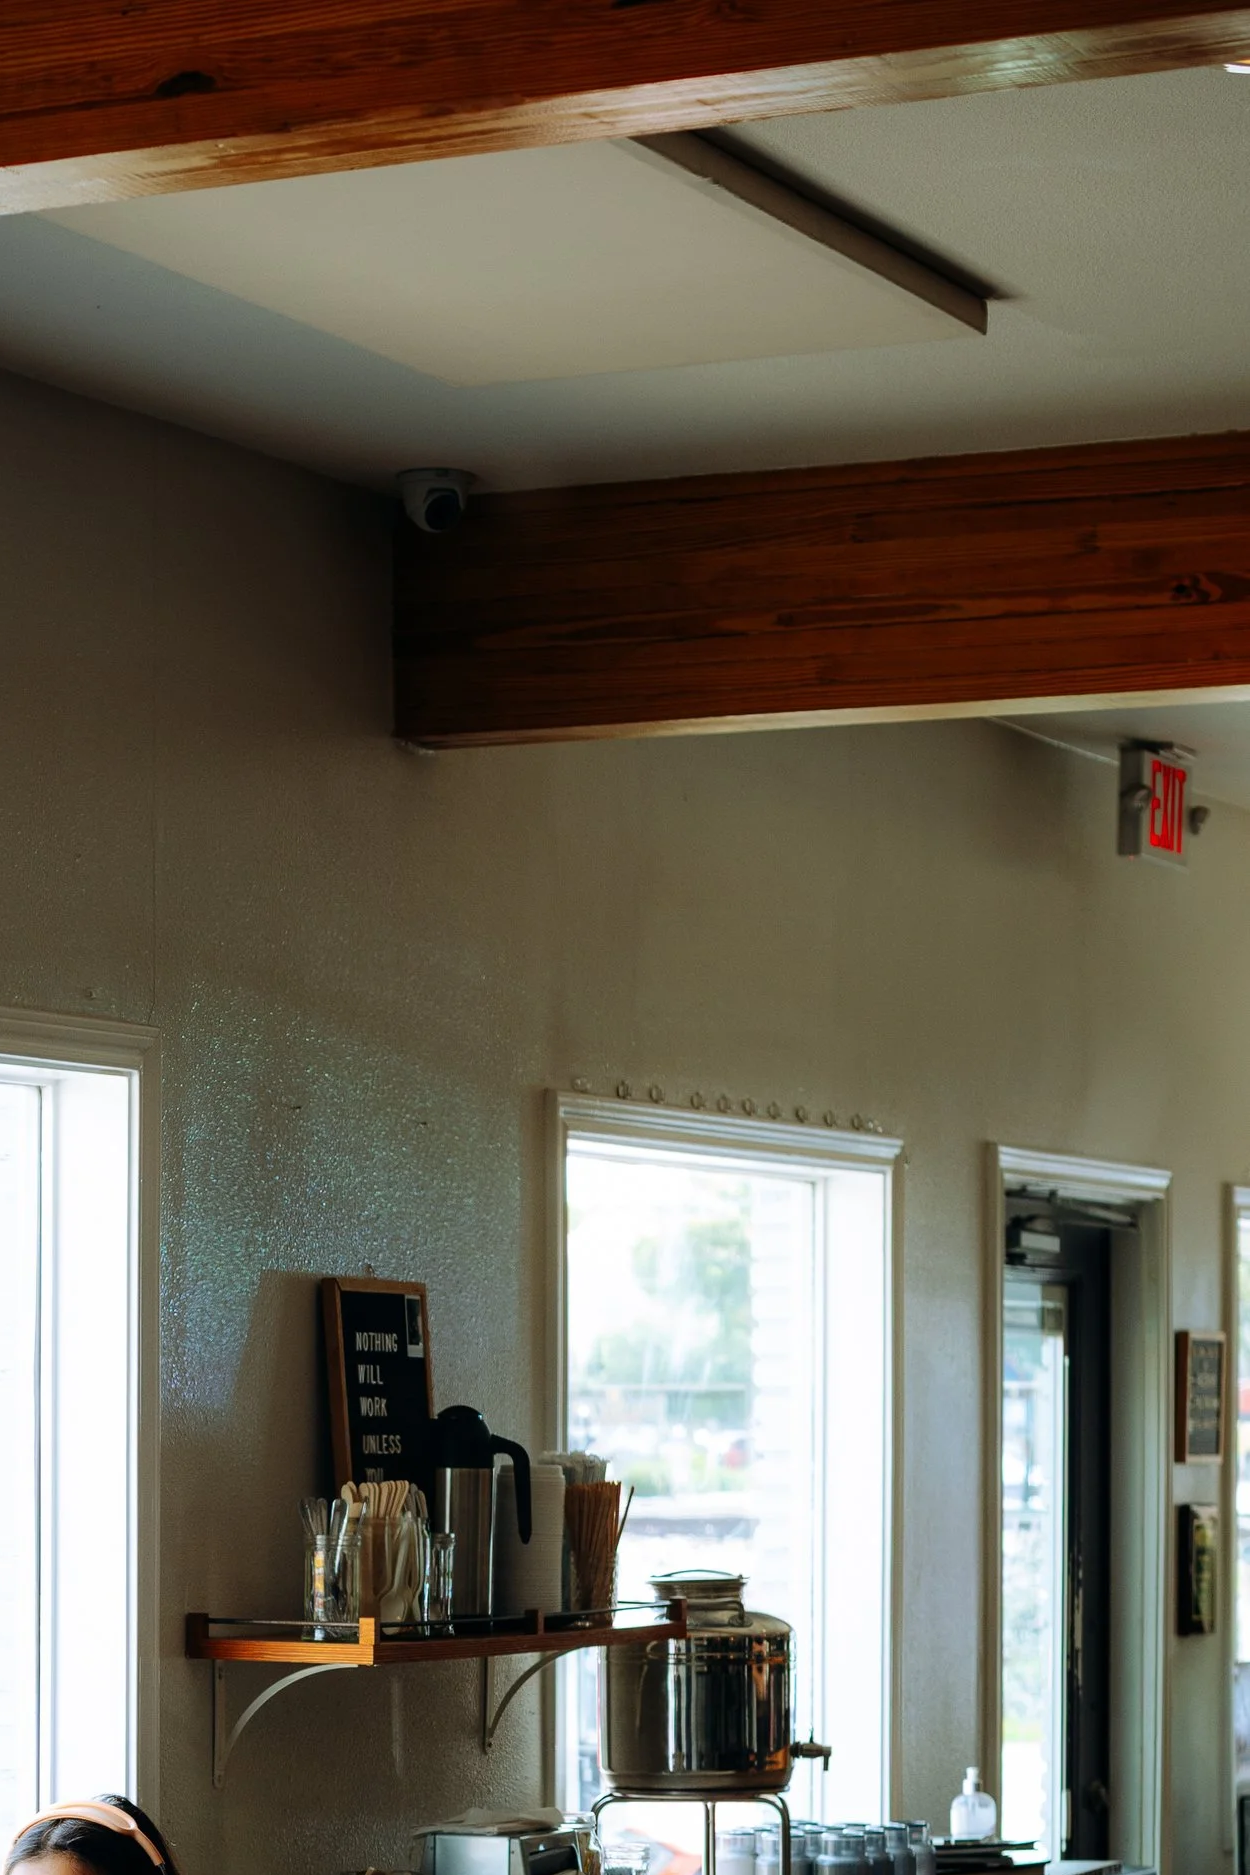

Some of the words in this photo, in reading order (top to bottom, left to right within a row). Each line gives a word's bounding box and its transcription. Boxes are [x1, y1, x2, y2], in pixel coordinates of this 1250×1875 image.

[1150, 759, 1187, 854] EXIT
[355, 1331, 398, 1352] NOTHING
[358, 1364, 384, 1385] WILL
[360, 1397, 388, 1417] WORK
[362, 1434, 402, 1454] UNLESS
